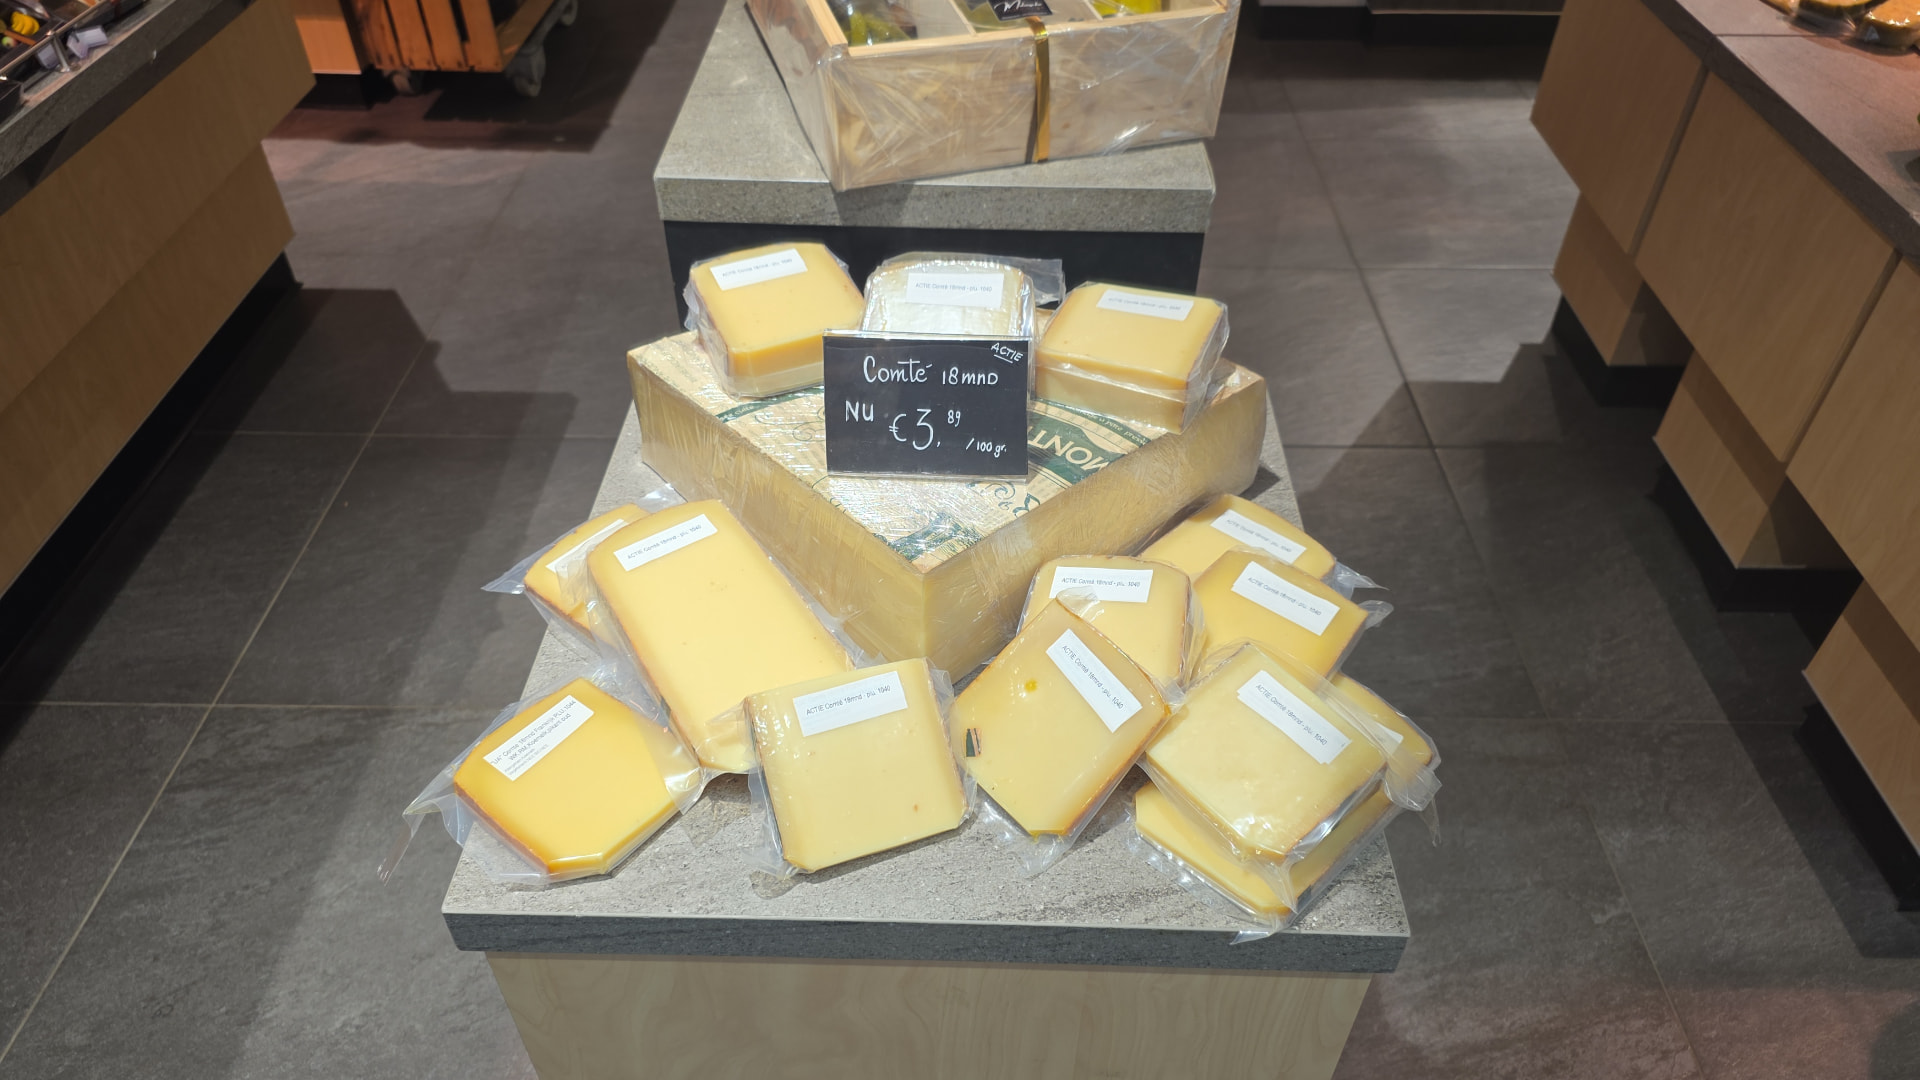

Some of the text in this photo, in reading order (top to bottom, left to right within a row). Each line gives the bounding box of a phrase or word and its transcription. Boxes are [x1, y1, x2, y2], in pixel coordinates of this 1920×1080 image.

[991, 342, 1023, 361] ACTIE
[863, 356, 933, 383] Comté
[1062, 645, 1077, 660] ACTIE
[1256, 684, 1273, 699] ACTIE
[806, 704, 824, 715] ACTIE
